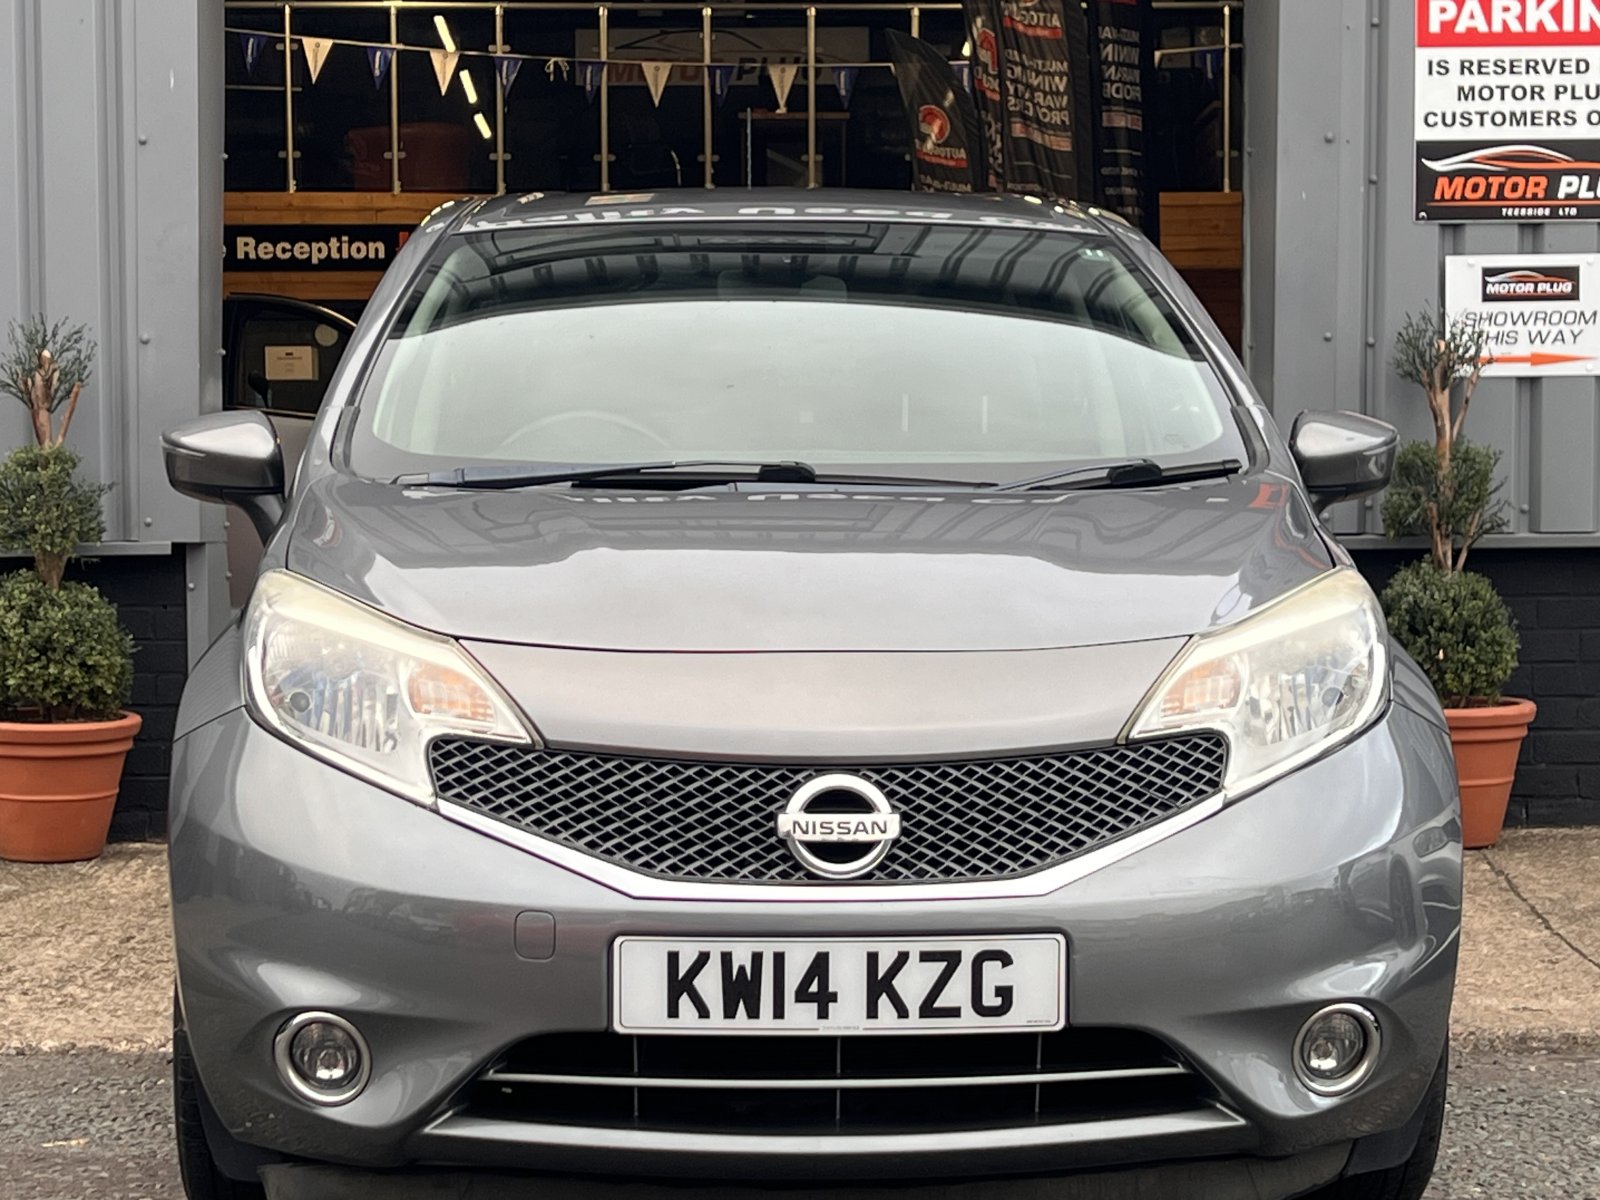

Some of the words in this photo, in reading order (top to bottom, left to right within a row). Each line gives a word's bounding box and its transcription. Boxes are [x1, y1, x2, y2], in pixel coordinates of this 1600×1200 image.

[1427, 59, 1450, 76] IS
[1460, 58, 1590, 76] RESERVED
[1457, 84, 1545, 101] MOTOR
[1554, 83, 1600, 101] PLU
[1423, 110, 1578, 127] CUSTOMERS
[1434, 175, 1549, 200] MOTOR
[236, 235, 386, 265] Reception
[1485, 282, 1534, 295] MOTOR
[1537, 281, 1573, 293] PLUG
[1465, 309, 1598, 327] SHOWROOM
[1471, 330, 1519, 346] HIS
[1527, 328, 1584, 345] WAY
[792, 820, 887, 835] NISSAN
[666, 950, 838, 1020] KW14
[866, 949, 1014, 1019] KZG
